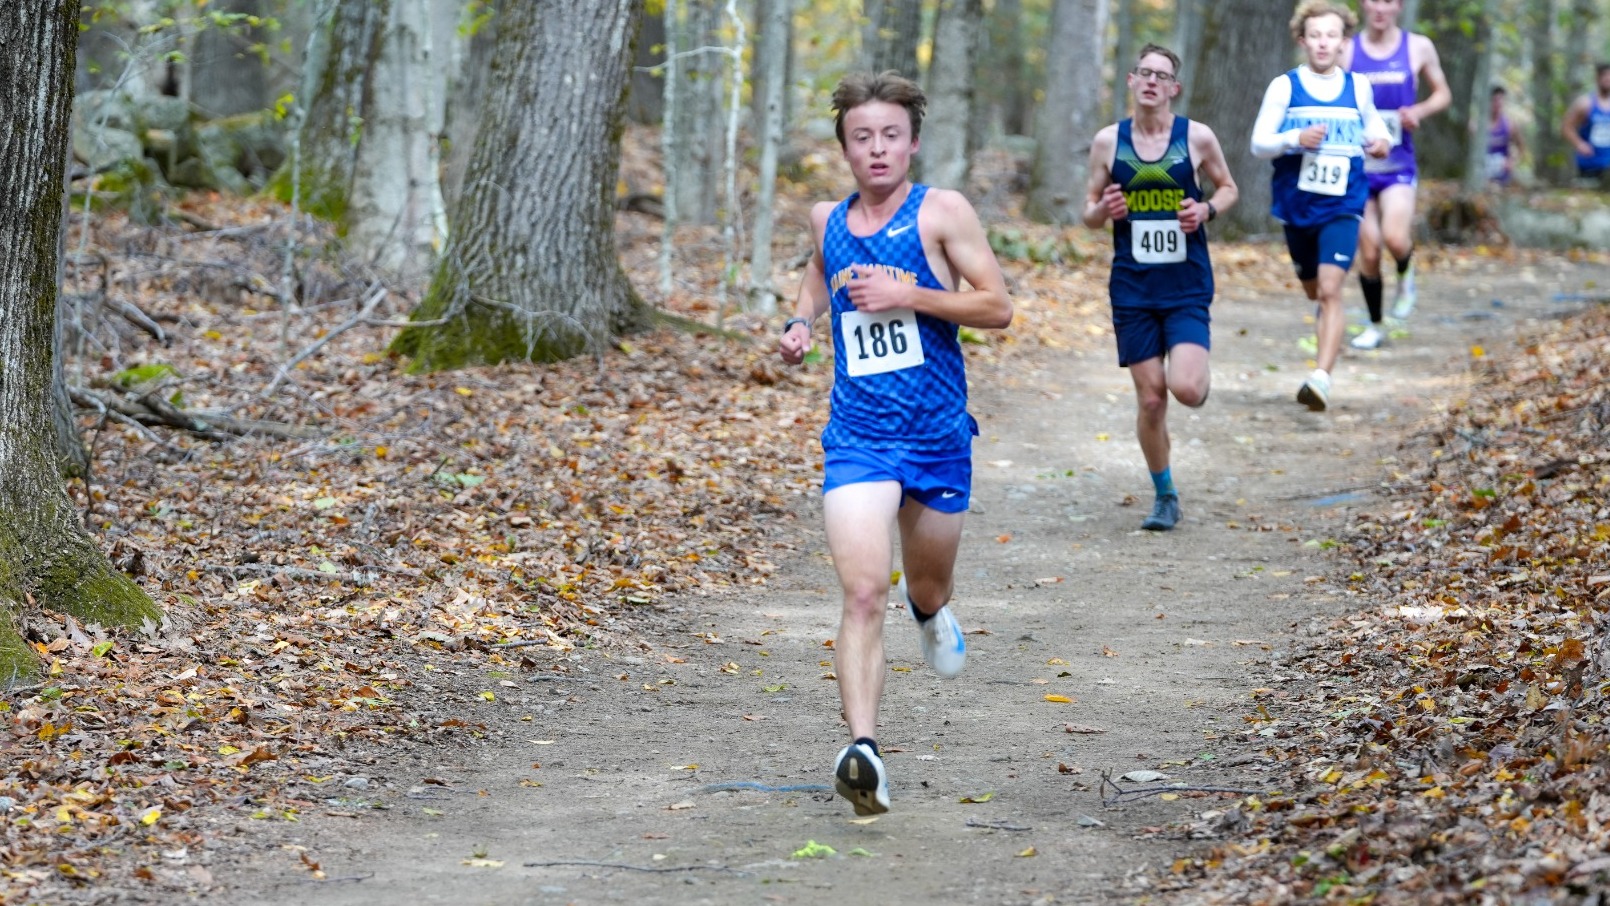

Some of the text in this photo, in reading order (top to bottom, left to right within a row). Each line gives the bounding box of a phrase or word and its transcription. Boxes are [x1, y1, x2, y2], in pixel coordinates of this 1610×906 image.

[1307, 161, 1341, 185] 319
[1123, 188, 1185, 212] MOOSE
[1141, 230, 1178, 253] 409
[854, 319, 908, 360] 186
